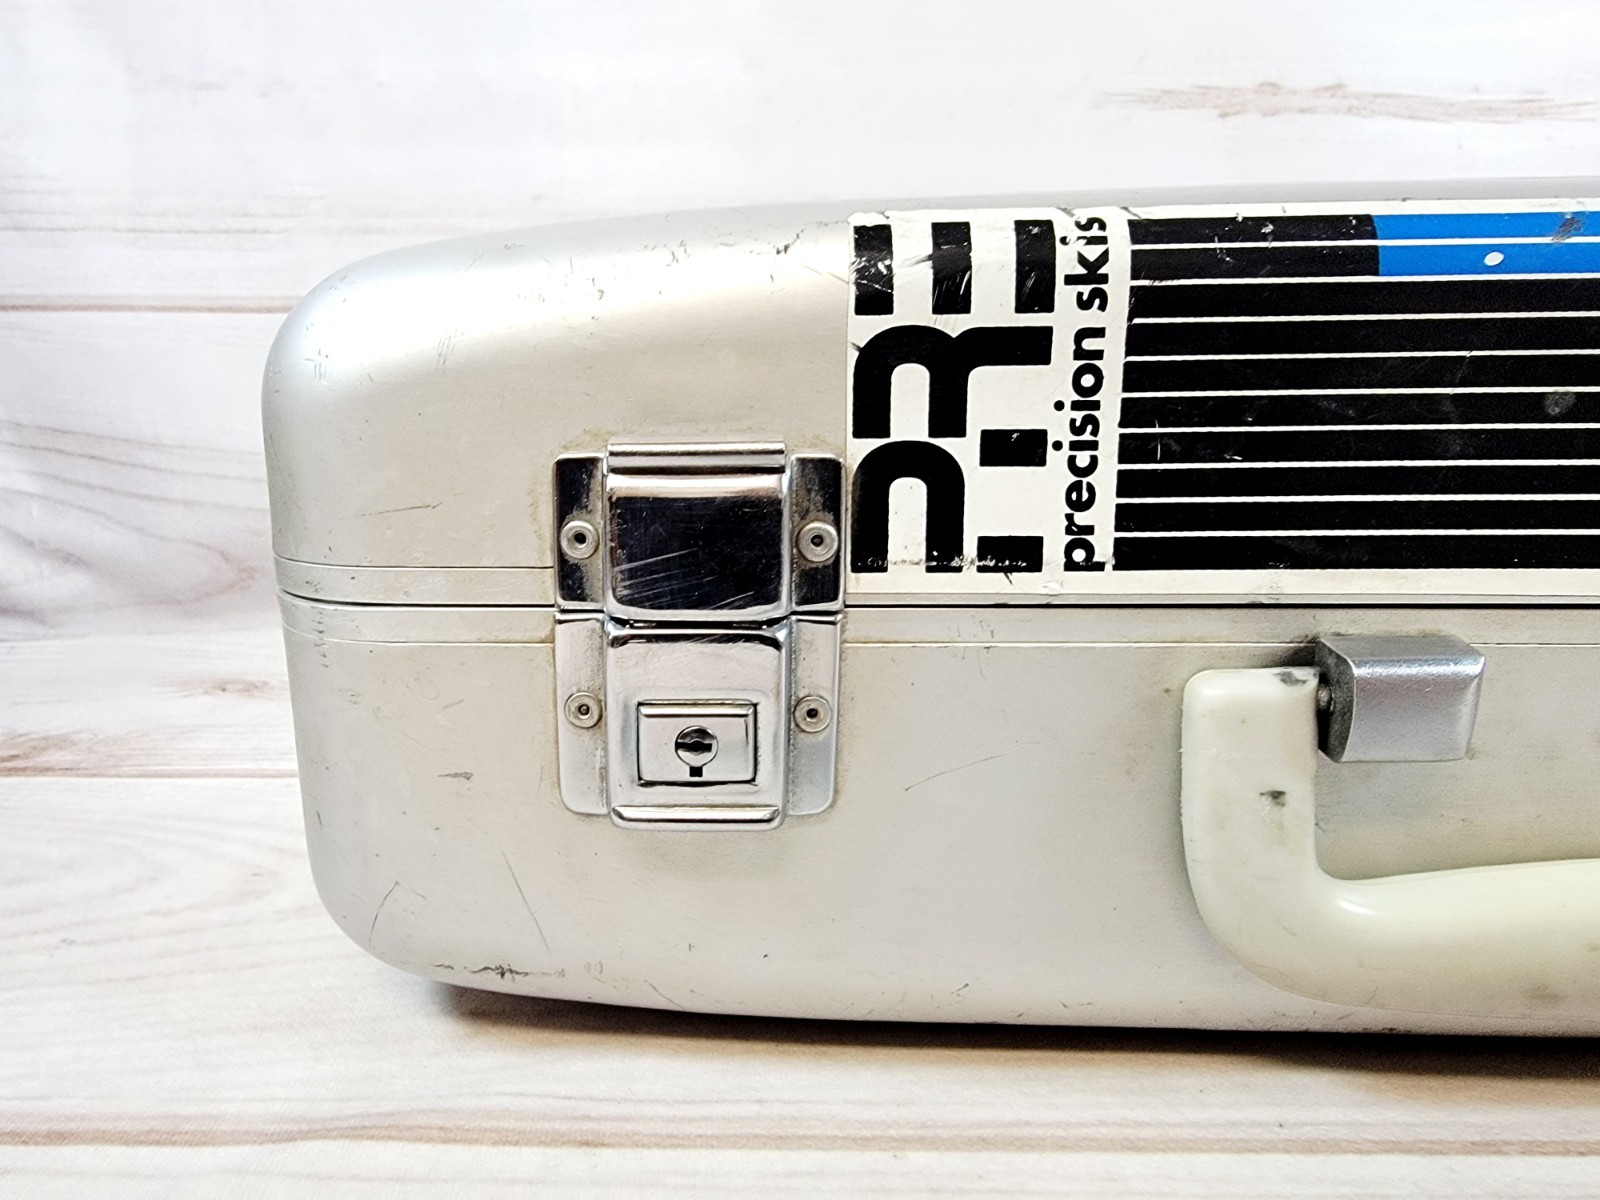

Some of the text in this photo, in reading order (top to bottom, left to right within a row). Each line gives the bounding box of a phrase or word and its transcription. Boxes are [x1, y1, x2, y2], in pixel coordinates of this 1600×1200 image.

[850, 219, 1056, 573] PRE
[1051, 216, 1110, 572] precision skis
